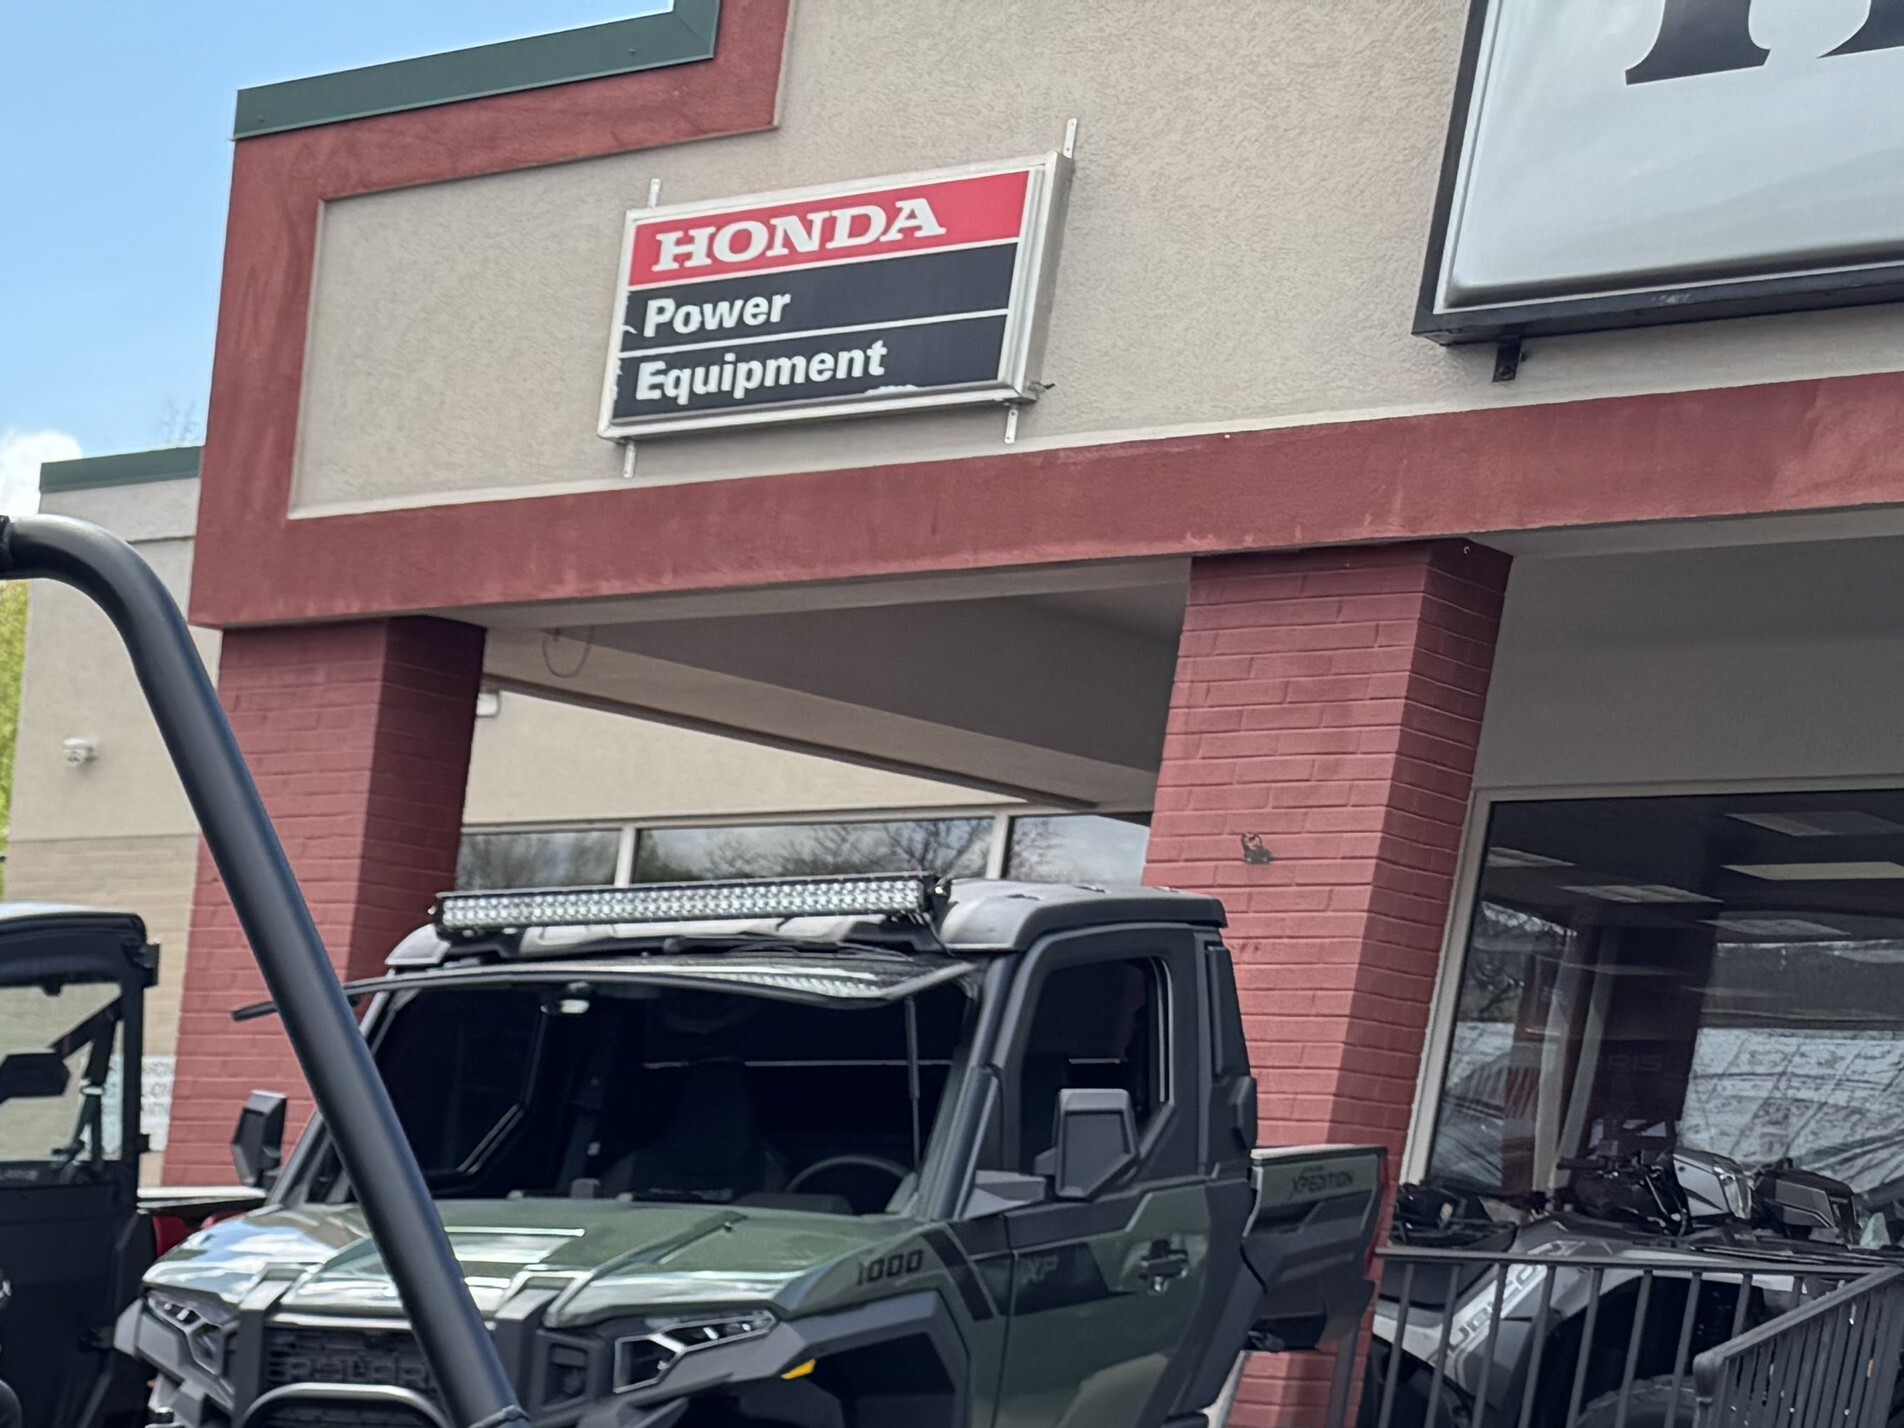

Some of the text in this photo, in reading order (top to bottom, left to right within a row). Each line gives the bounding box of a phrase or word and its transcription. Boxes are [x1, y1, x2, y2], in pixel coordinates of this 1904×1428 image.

[651, 197, 947, 272] HONDA
[643, 292, 792, 337] Power
[635, 339, 888, 405] Equipment
[856, 1250, 925, 1286] 1000
